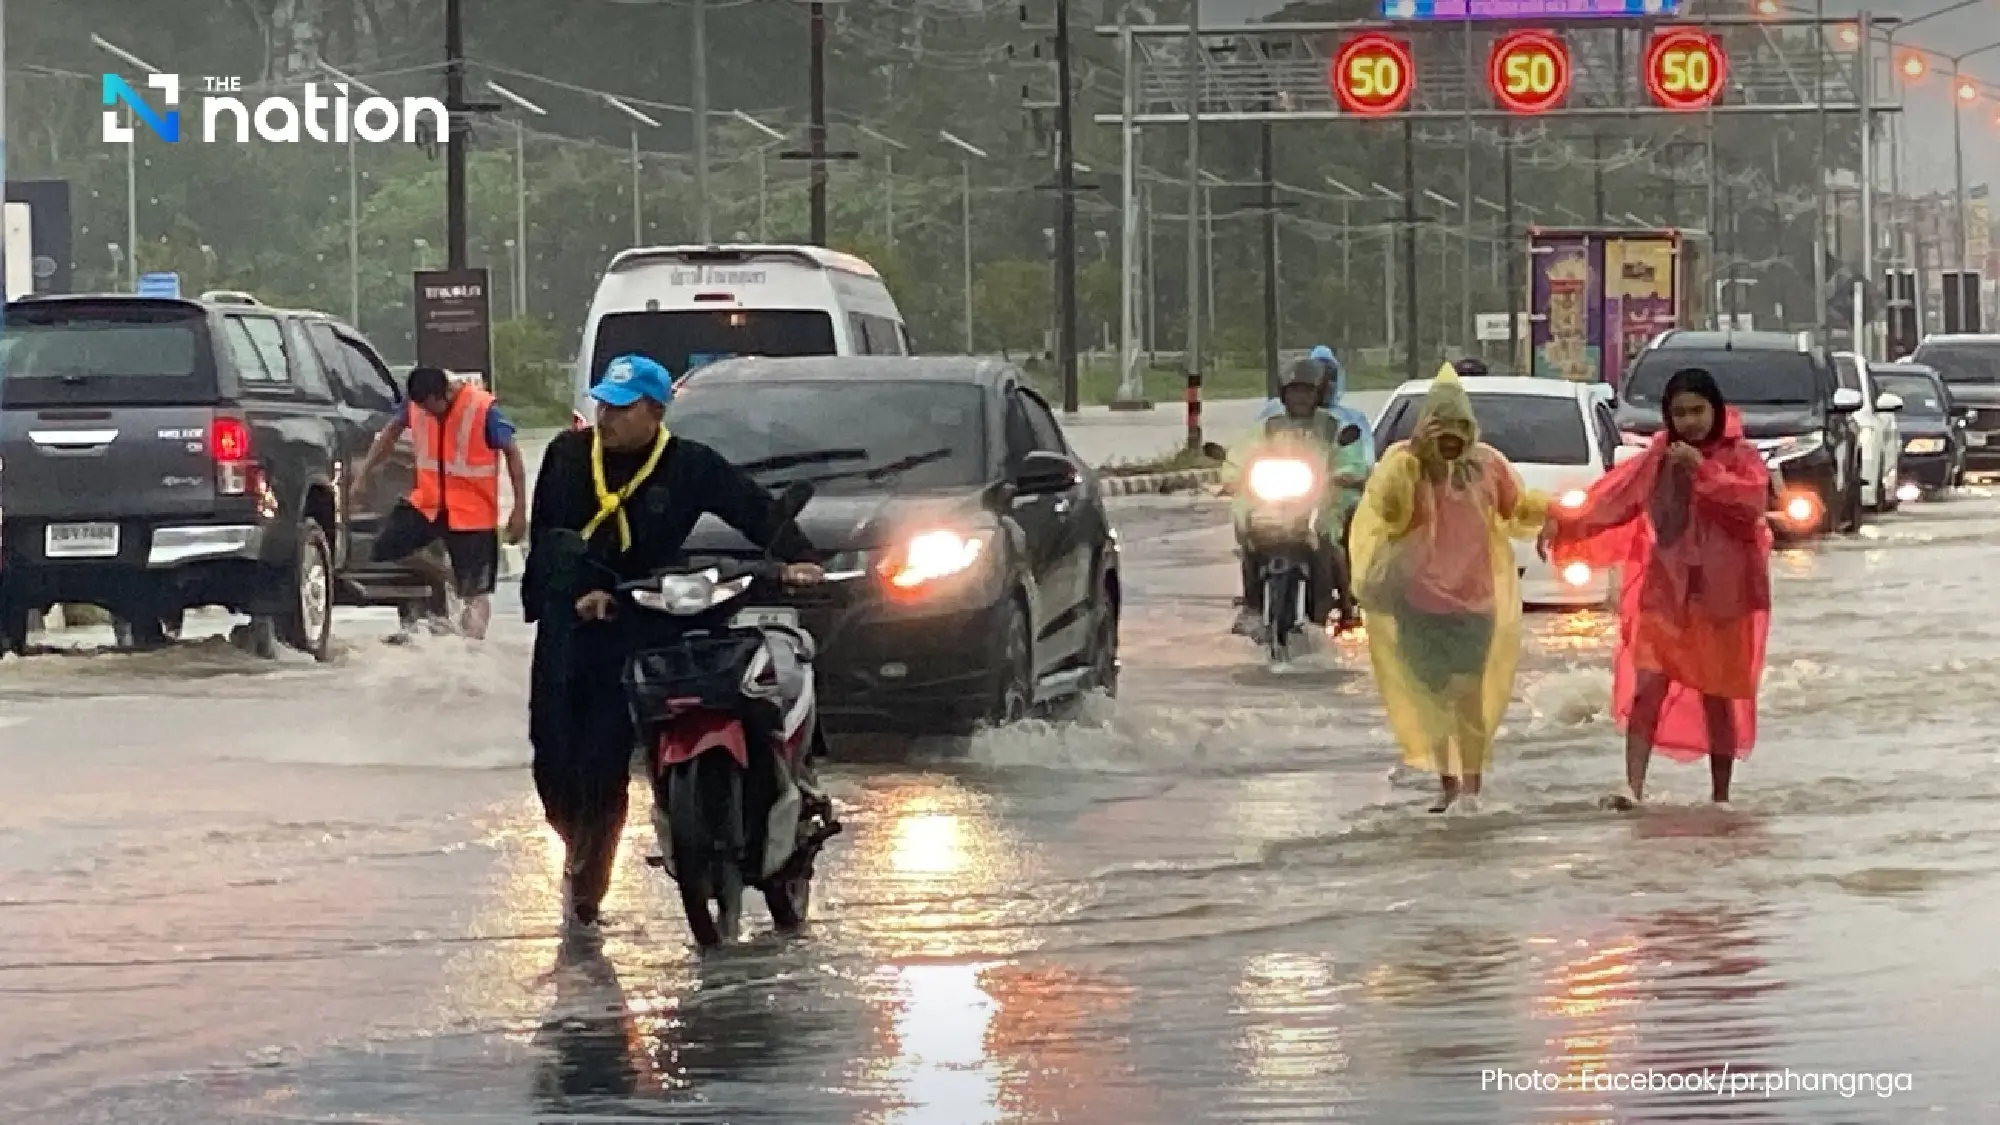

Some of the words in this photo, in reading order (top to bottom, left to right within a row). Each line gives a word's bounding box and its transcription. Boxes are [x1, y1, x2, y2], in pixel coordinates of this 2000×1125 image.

[1349, 56, 1399, 96] 50
[1504, 53, 1554, 94] 50
[1662, 51, 1709, 92] 50
